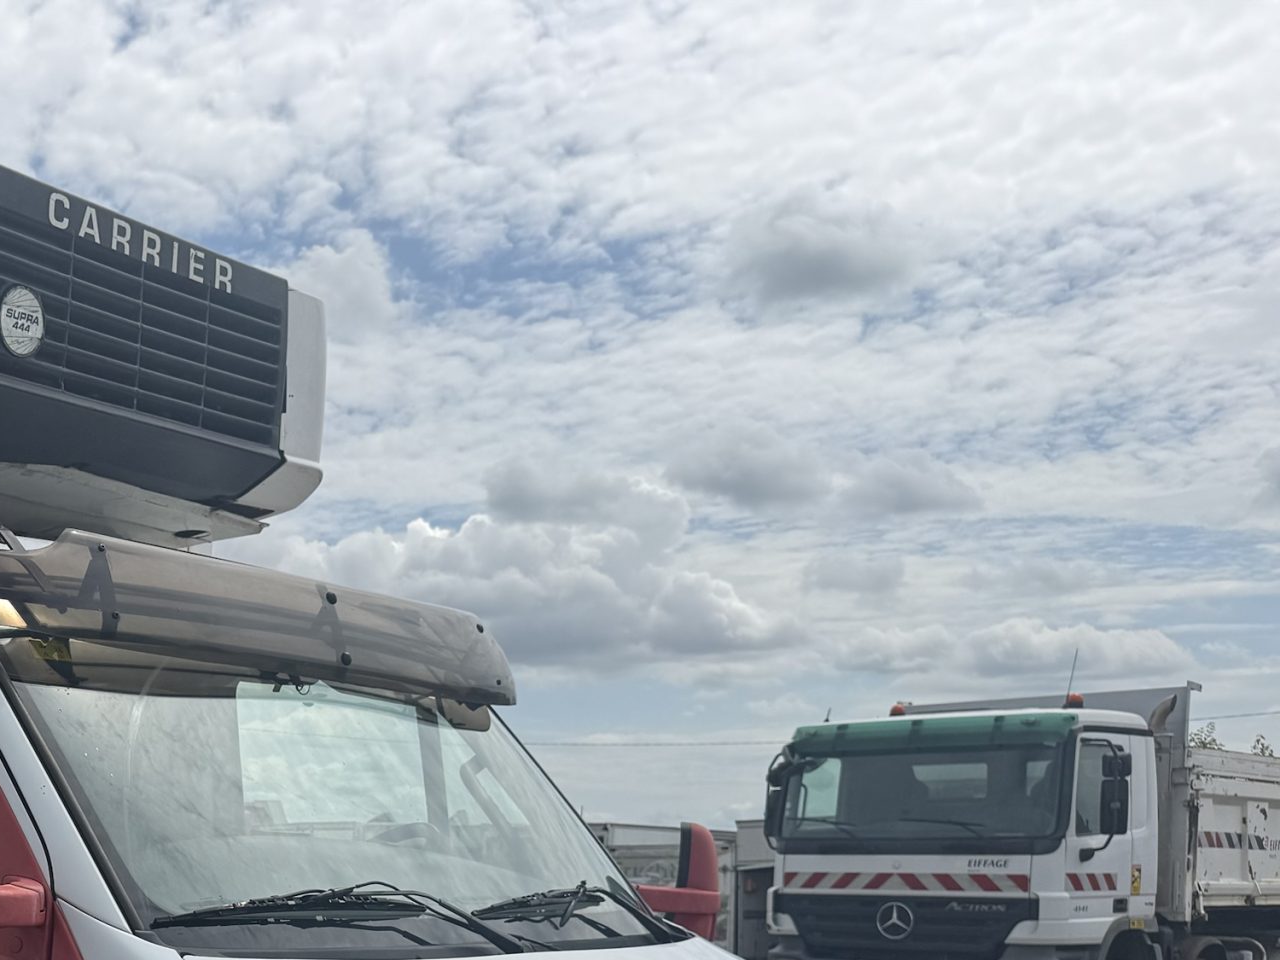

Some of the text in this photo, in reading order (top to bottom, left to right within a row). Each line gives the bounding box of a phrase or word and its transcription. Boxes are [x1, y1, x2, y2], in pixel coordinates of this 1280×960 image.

[48, 191, 233, 294] CARRIER
[5, 307, 39, 326] SUPRA
[12, 321, 31, 333] 444
